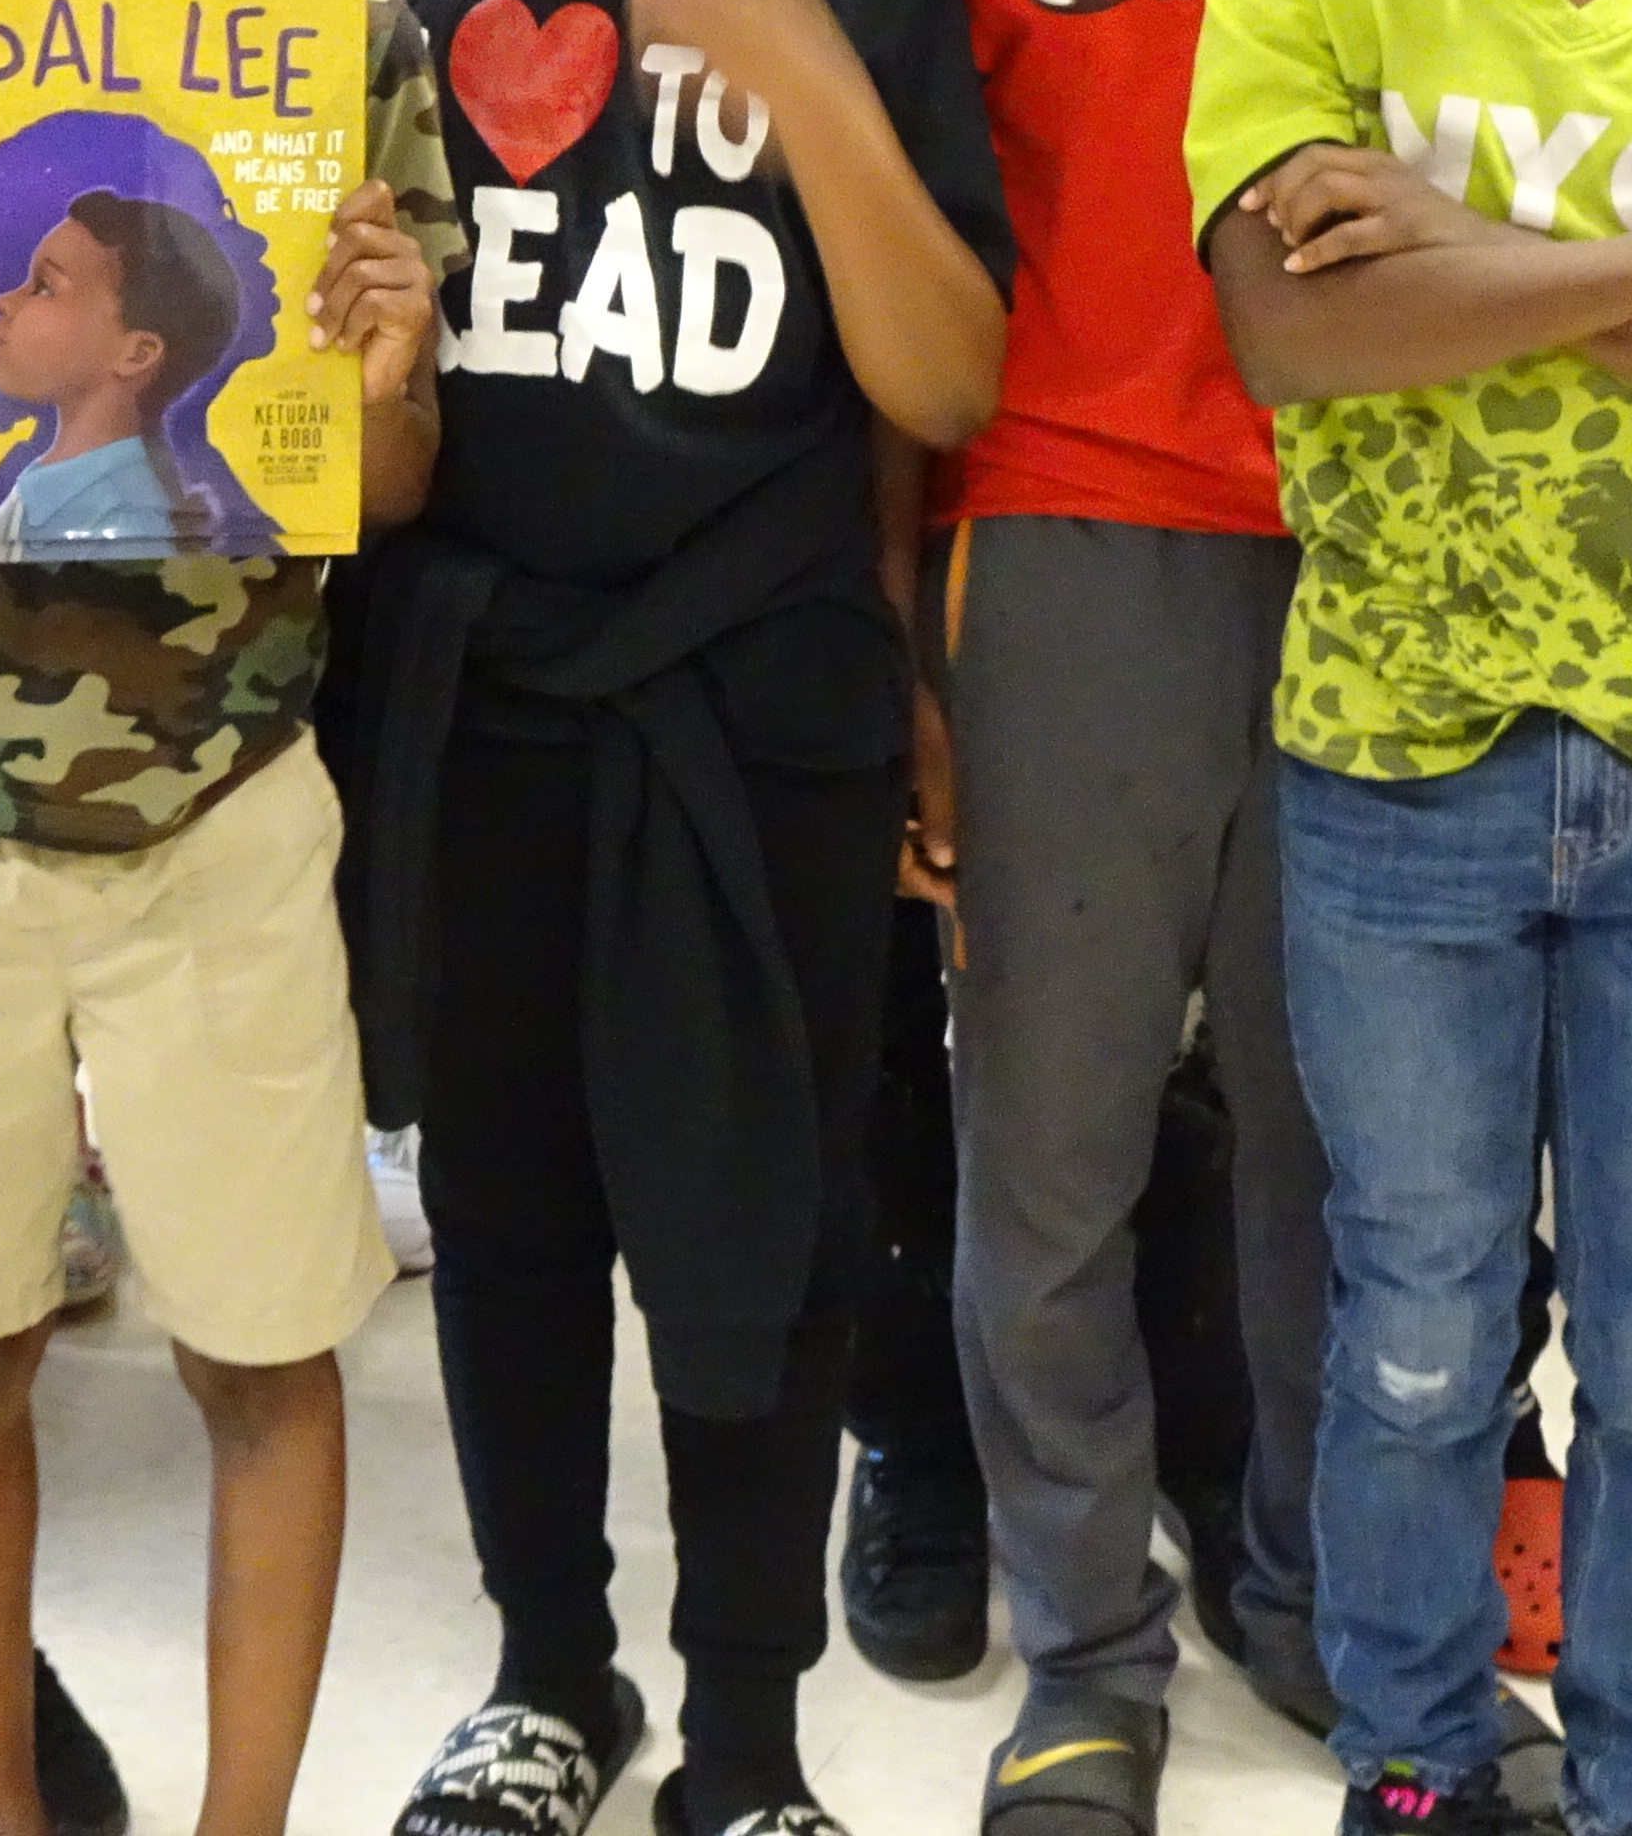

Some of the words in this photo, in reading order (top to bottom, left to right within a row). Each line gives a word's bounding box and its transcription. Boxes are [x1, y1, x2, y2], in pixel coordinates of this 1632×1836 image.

[180, 1, 318, 118] LEE
[209, 129, 254, 155] AND
[263, 130, 317, 156] WHAT
[326, 129, 345, 155] IT
[234, 158, 305, 185] MEANS
[316, 159, 342, 183] TO
[255, 187, 282, 214] BE
[291, 187, 341, 213] FREE
[436, 185, 786, 396] EAD
